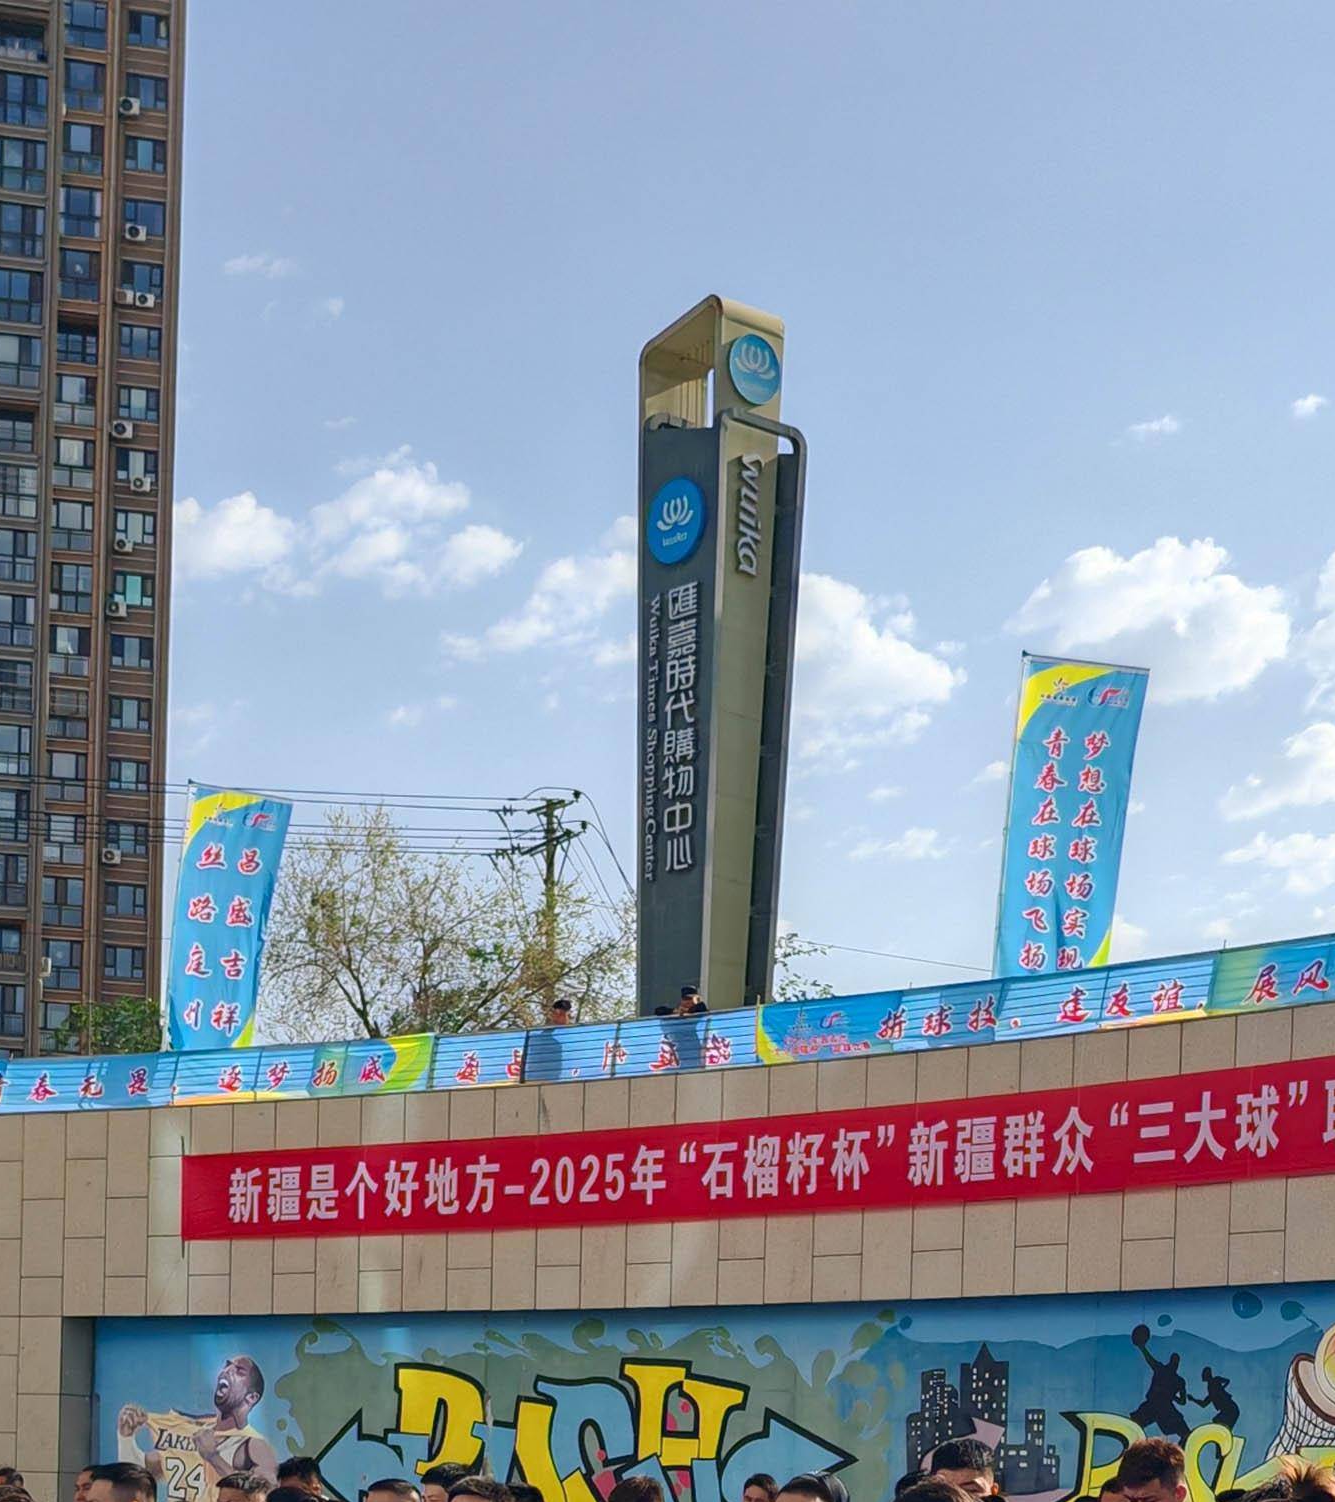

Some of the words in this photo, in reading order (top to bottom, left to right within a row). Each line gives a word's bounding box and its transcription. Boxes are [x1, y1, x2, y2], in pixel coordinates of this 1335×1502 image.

[647, 659, 659, 723] Times
[662, 580, 699, 872] 匯嘉時代購物中心
[211, 849, 262, 1035] 昌盛吉祥
[1019, 726, 1071, 973] 青春在球场飞扬
[1056, 730, 1112, 971] 梦想在球场实现
[166, 1456, 206, 1501] 24
